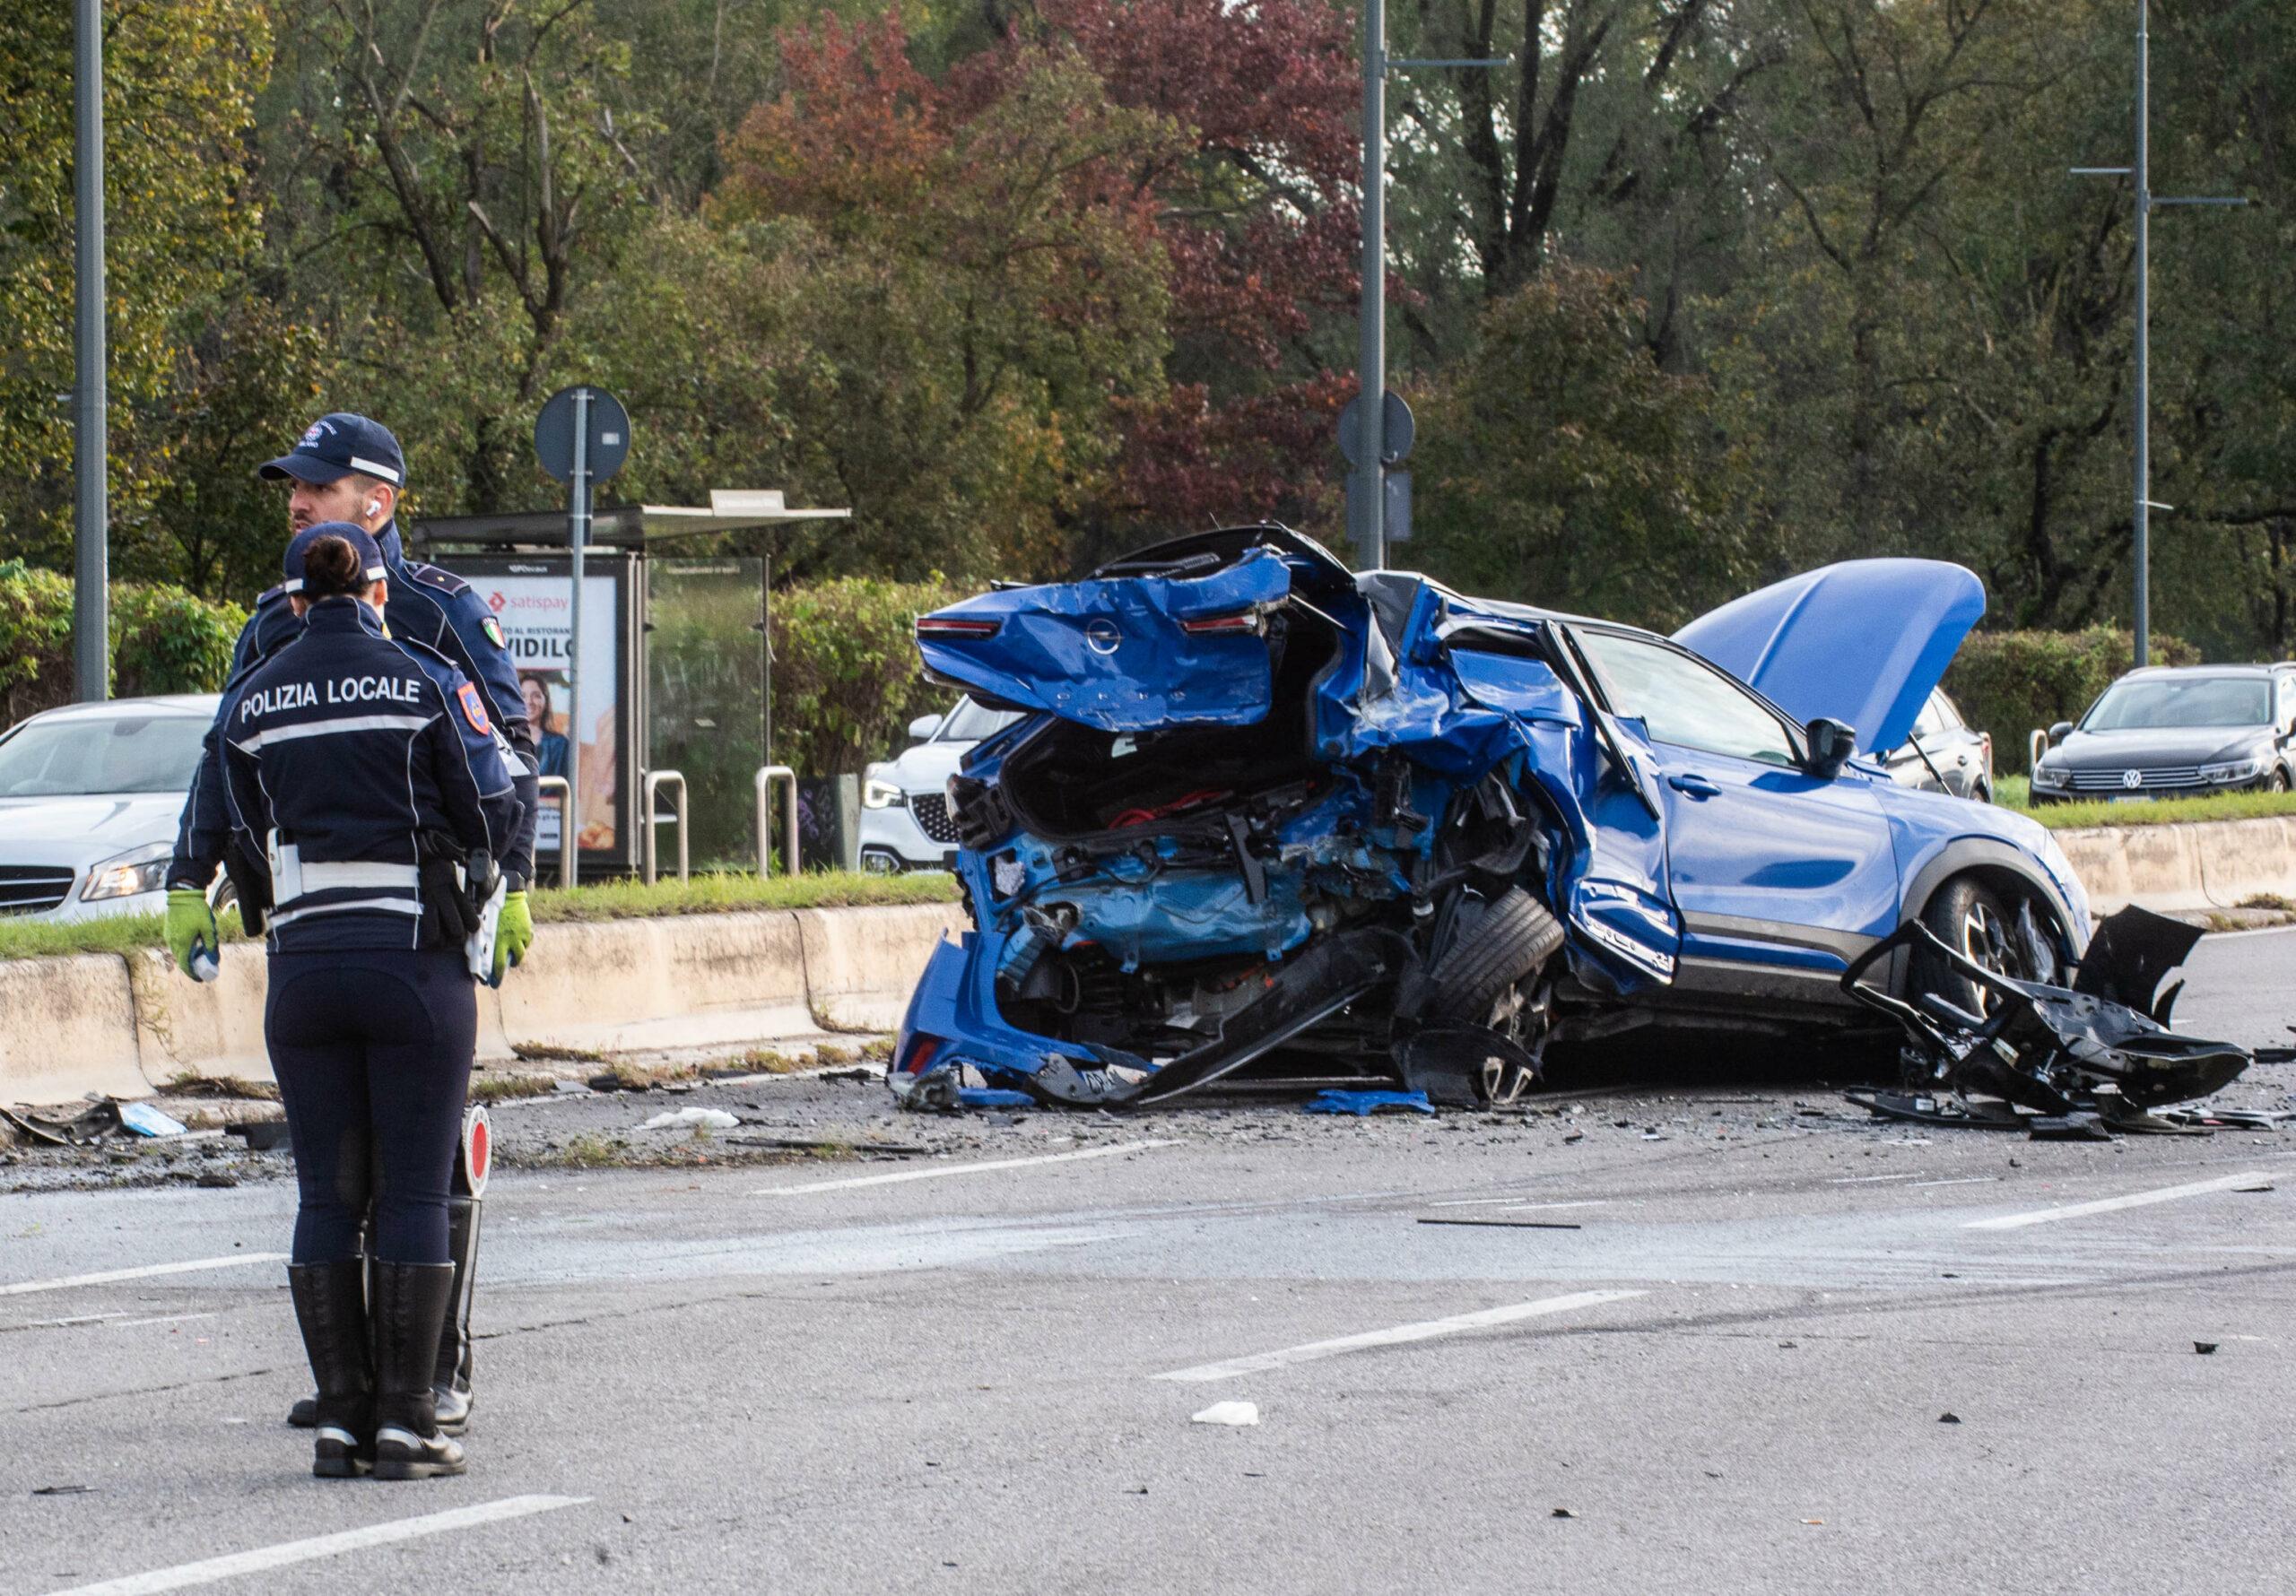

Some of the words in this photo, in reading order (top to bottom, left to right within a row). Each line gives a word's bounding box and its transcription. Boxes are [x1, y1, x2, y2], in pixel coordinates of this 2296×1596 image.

[509, 595, 568, 612] satispay
[507, 638, 573, 657] VIDIL
[241, 681, 318, 724] POLIZIA
[327, 676, 421, 703] LOCALE
